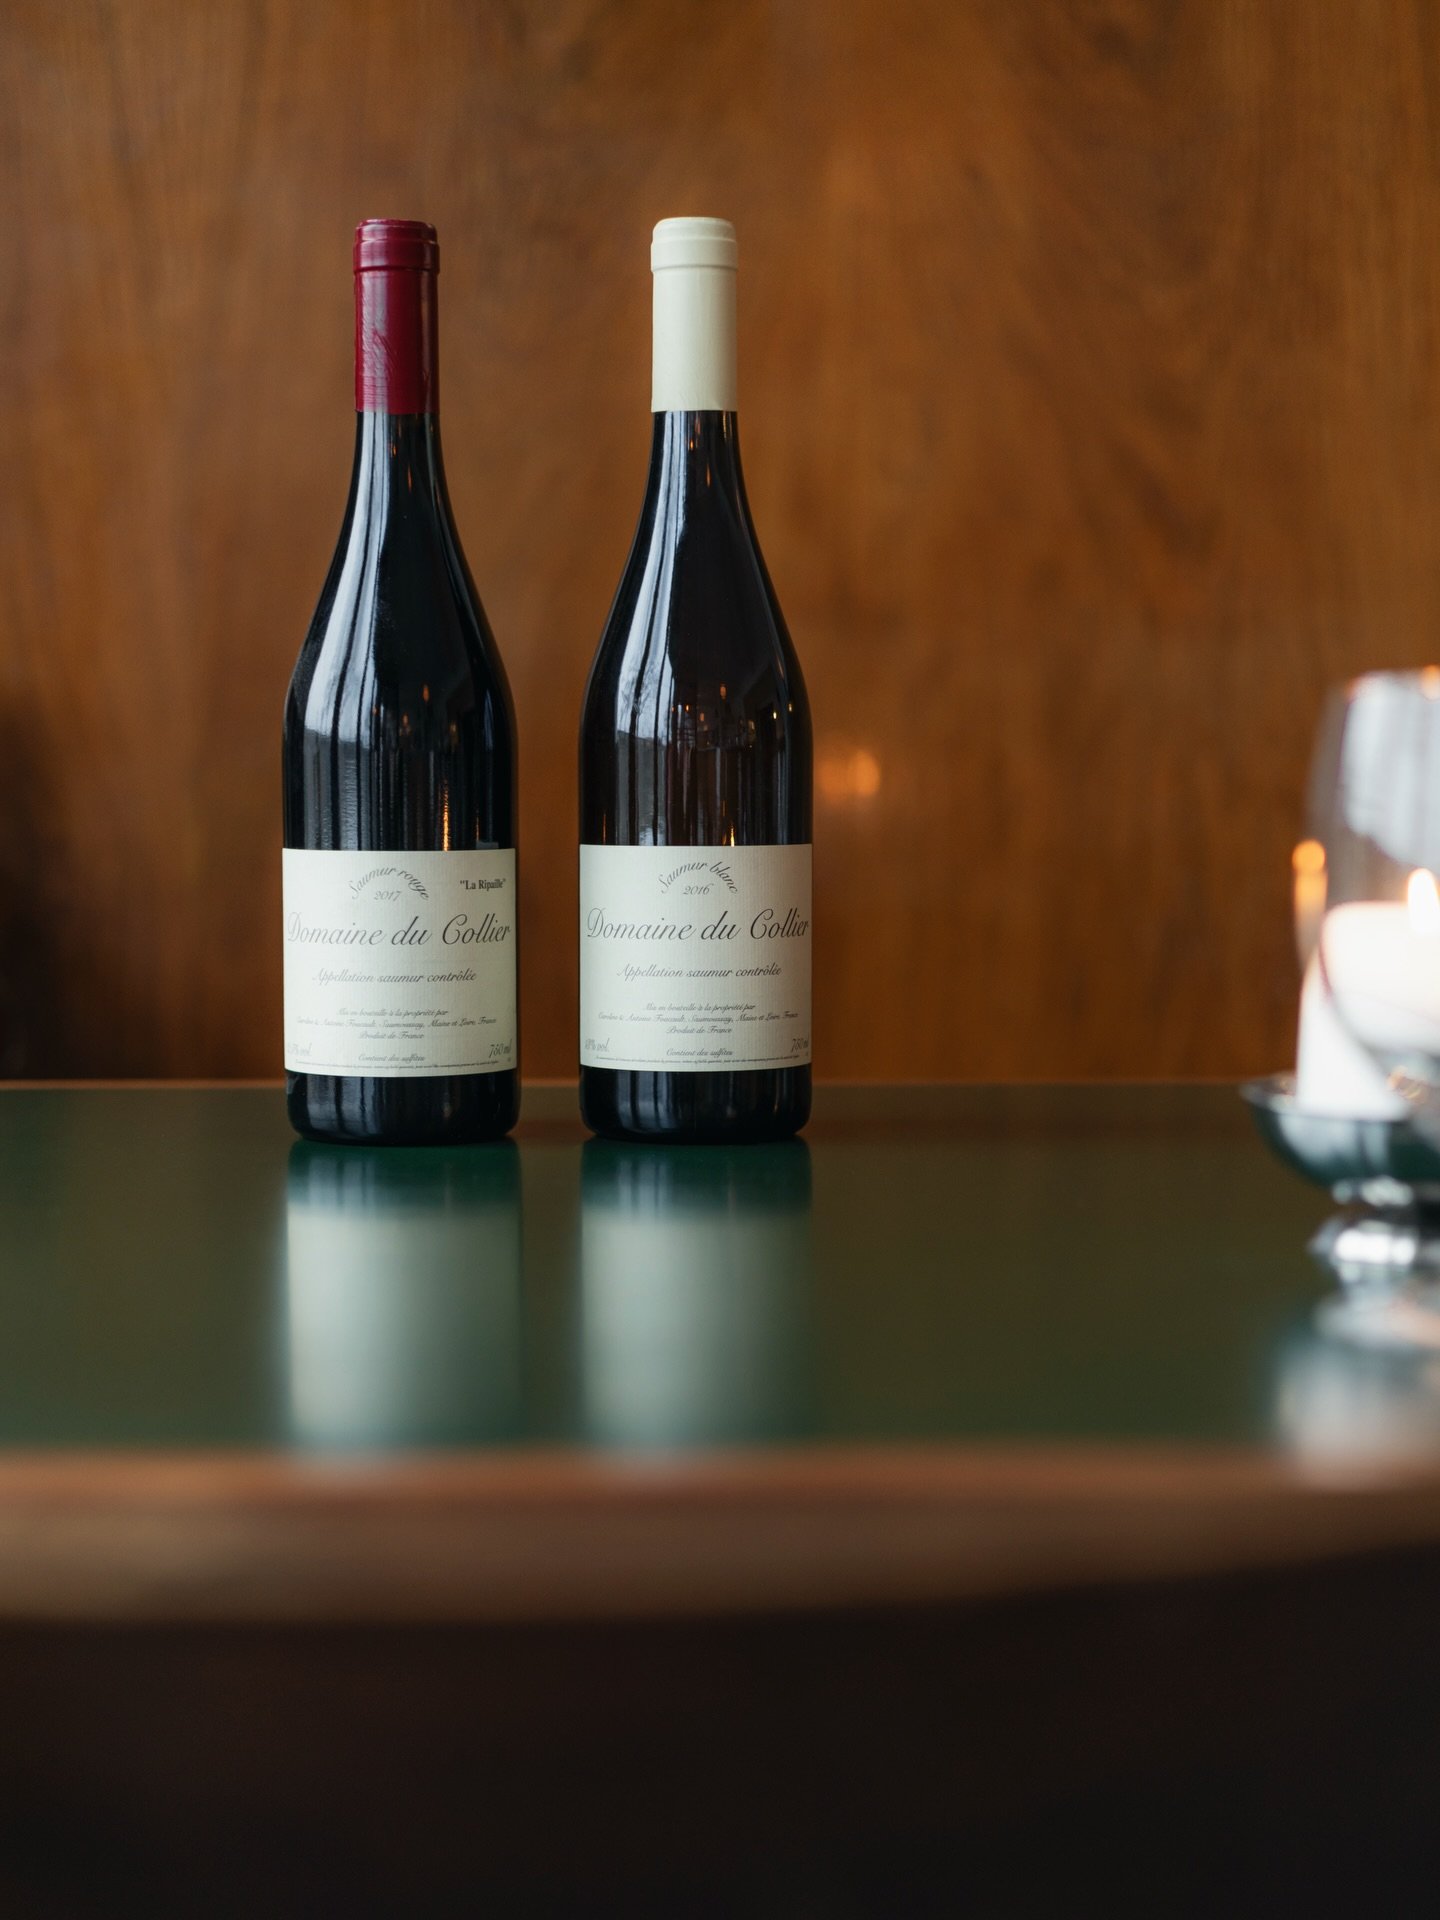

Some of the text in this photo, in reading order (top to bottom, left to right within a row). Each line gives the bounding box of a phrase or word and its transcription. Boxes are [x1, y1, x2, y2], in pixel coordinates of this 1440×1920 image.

[349, 867, 430, 900] Saumur rouge
[658, 861, 738, 894] Saumur blanc
[683, 883, 714, 895] 2016
[374, 890, 402, 901] 2017
[287, 911, 512, 946] Domaine du Collier
[587, 907, 809, 940] Domaine du Collier
[312, 968, 477, 986] Appellation saumur contrôlée
[617, 962, 782, 982] Appellation saumur contrôlée
